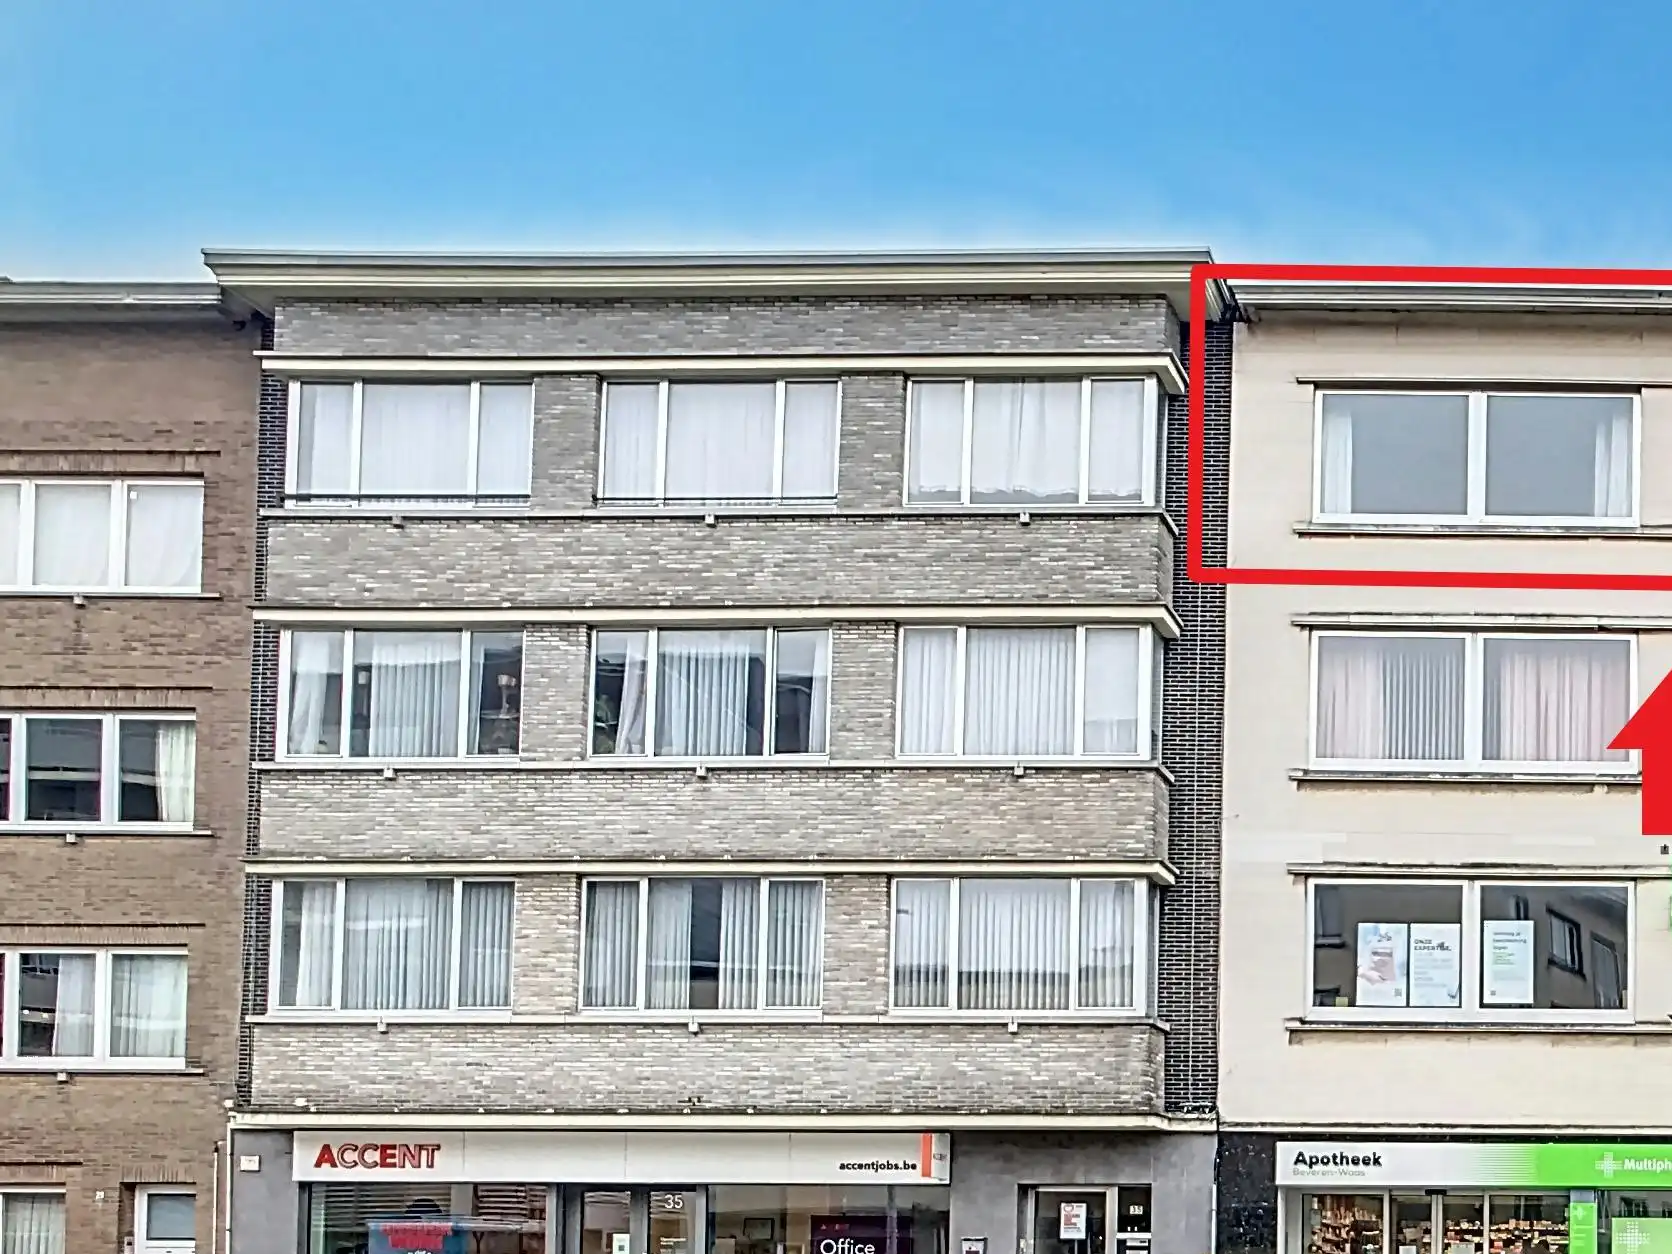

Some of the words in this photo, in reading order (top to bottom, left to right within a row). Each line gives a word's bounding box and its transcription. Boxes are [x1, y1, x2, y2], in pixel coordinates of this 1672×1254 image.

[314, 1142, 441, 1169] ACCENT
[1293, 1150, 1383, 1169] Apotheek
[838, 1160, 918, 1173] accentjobs.be
[1292, 1167, 1366, 1177] Beveren-Waas
[664, 1194, 684, 1209] 35
